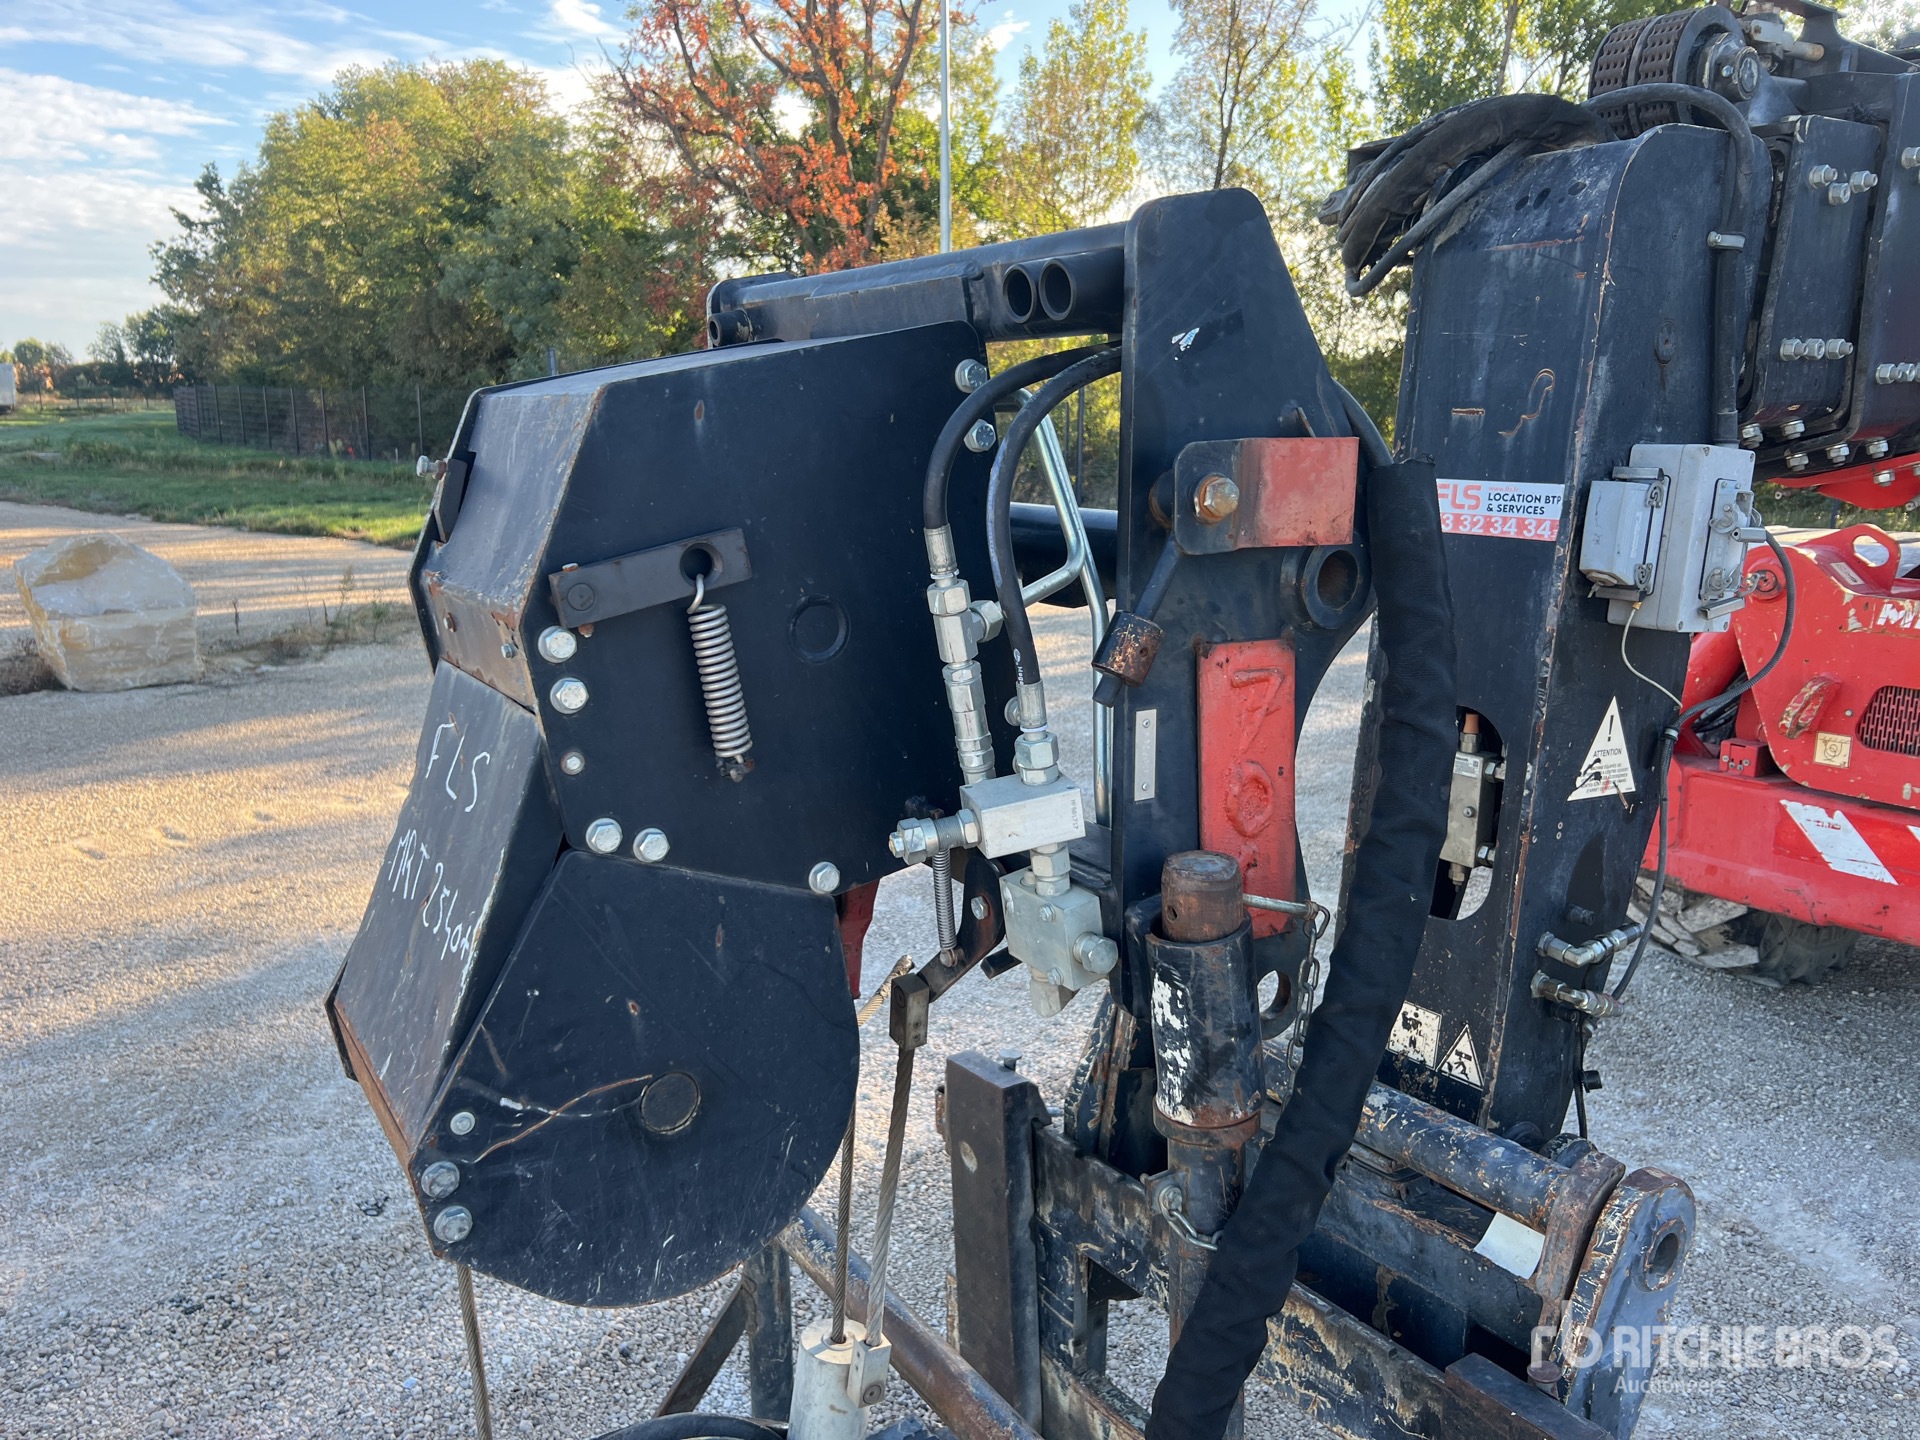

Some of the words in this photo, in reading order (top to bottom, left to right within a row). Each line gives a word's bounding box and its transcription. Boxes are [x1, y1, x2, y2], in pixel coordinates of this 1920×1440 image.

[1437, 484, 1482, 511] FLS
[1486, 503, 1494, 512] &
[1496, 504, 1545, 515] SERVICES
[1488, 492, 1541, 504] LOCATION
[1544, 496, 1561, 505] BTP
[1459, 514, 1485, 533] 32
[1490, 516, 1518, 537] 34
[1593, 748, 1622, 757] ATTENTION
[425, 722, 490, 813] FLS
[388, 828, 431, 900] MRT
